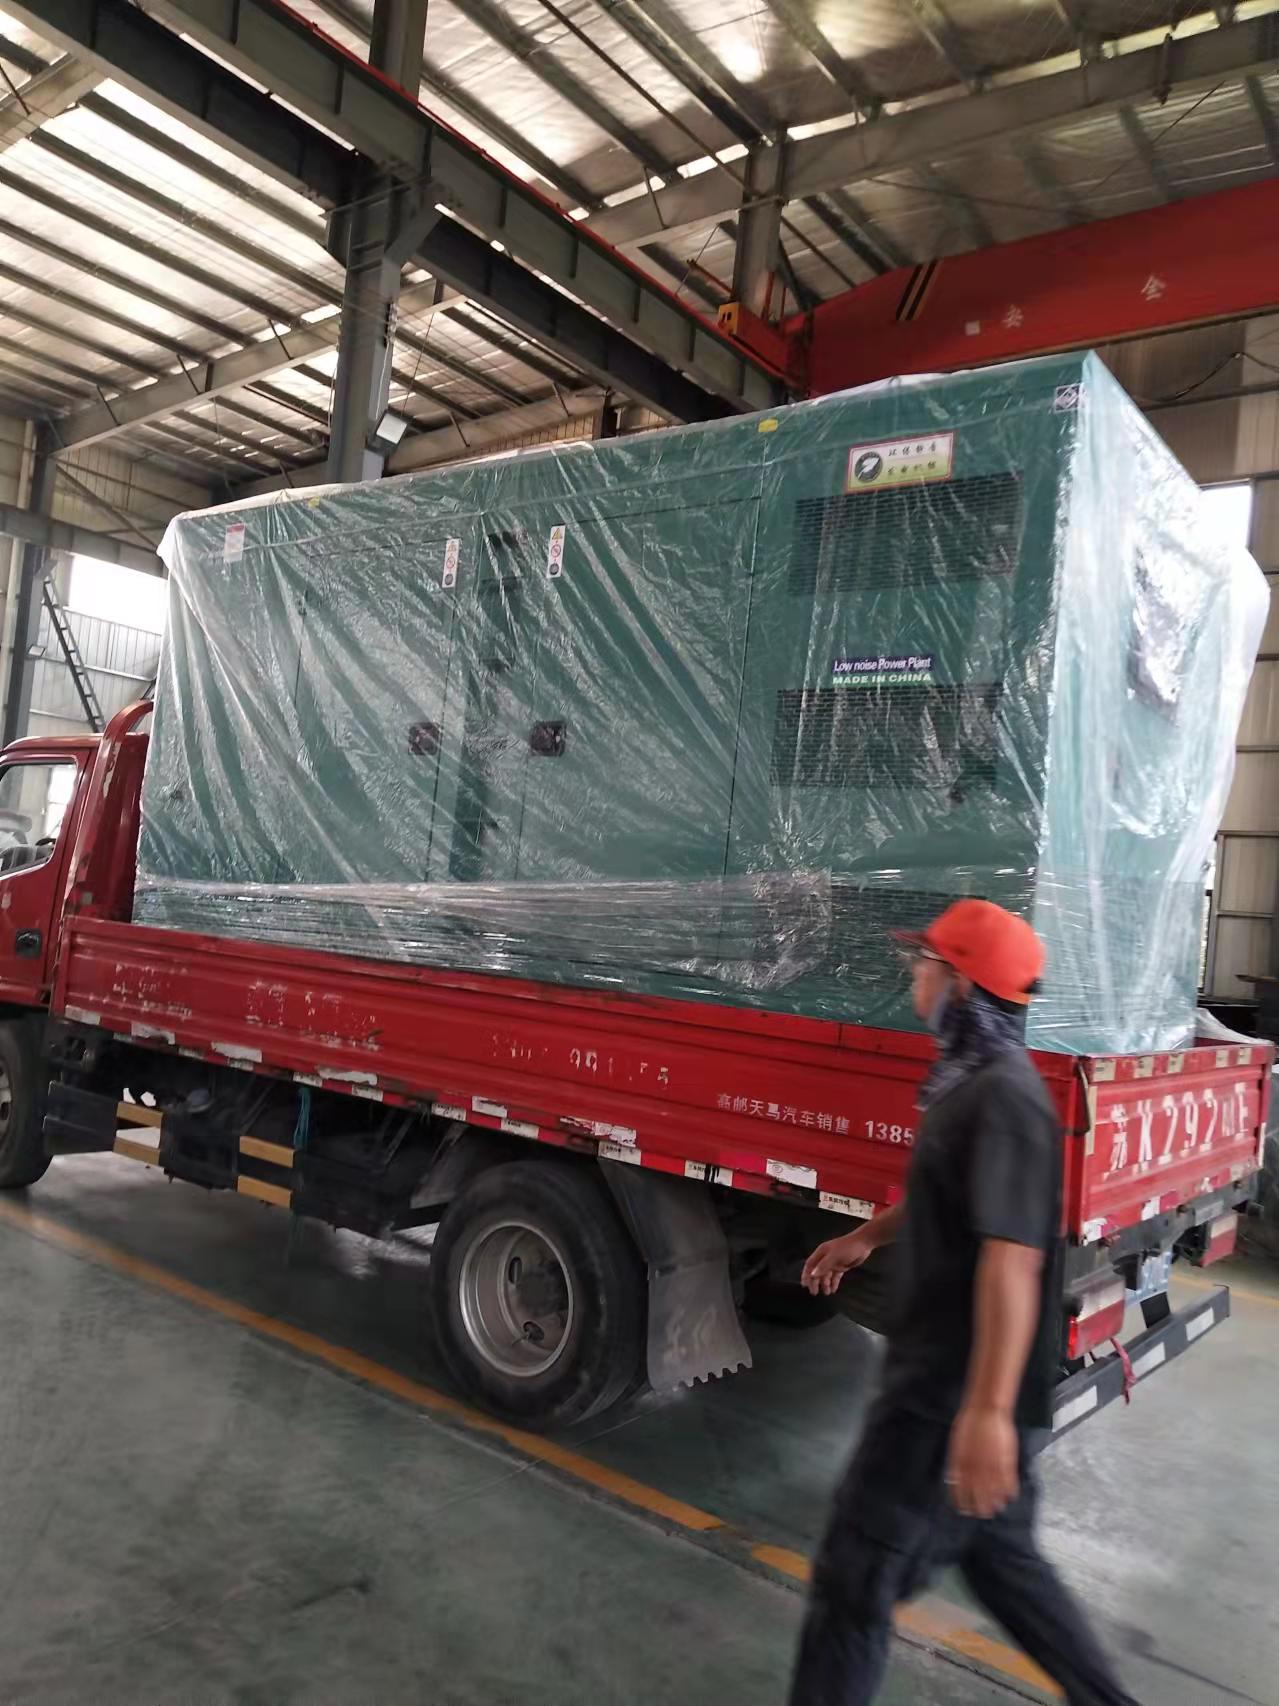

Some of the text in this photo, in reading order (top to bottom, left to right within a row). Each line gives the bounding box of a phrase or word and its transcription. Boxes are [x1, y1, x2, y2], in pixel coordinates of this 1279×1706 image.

[834, 657, 931, 672] Low noise Power Plant
[833, 673, 931, 684] MADE IN CHINA
